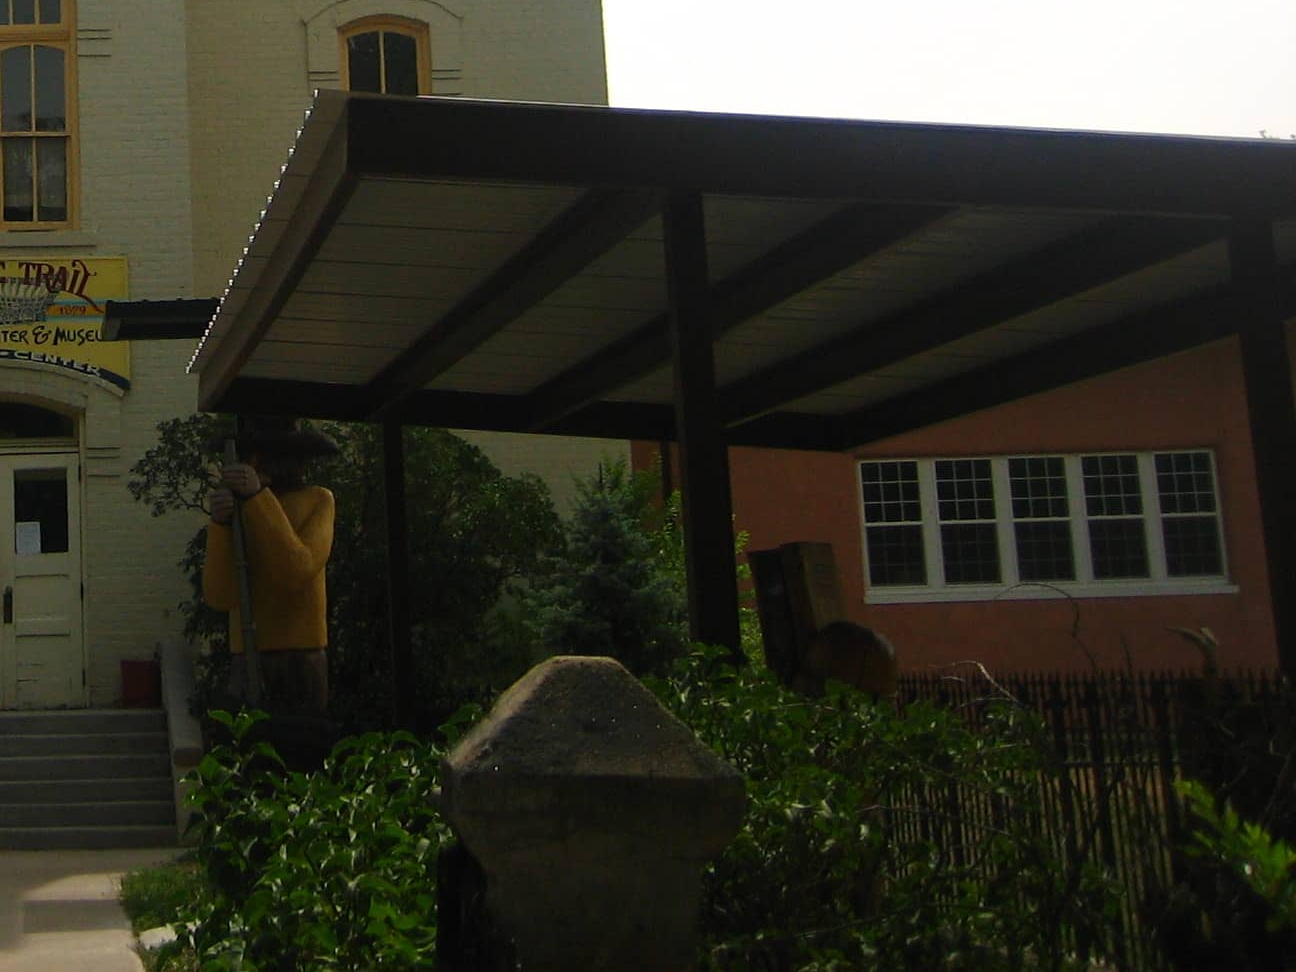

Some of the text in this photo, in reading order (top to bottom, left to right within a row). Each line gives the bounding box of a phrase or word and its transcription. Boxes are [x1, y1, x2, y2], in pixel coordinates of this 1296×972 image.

[32, 325, 52, 345] &
[53, 326, 102, 346] MUSEU
[13, 350, 102, 376] CENTER
